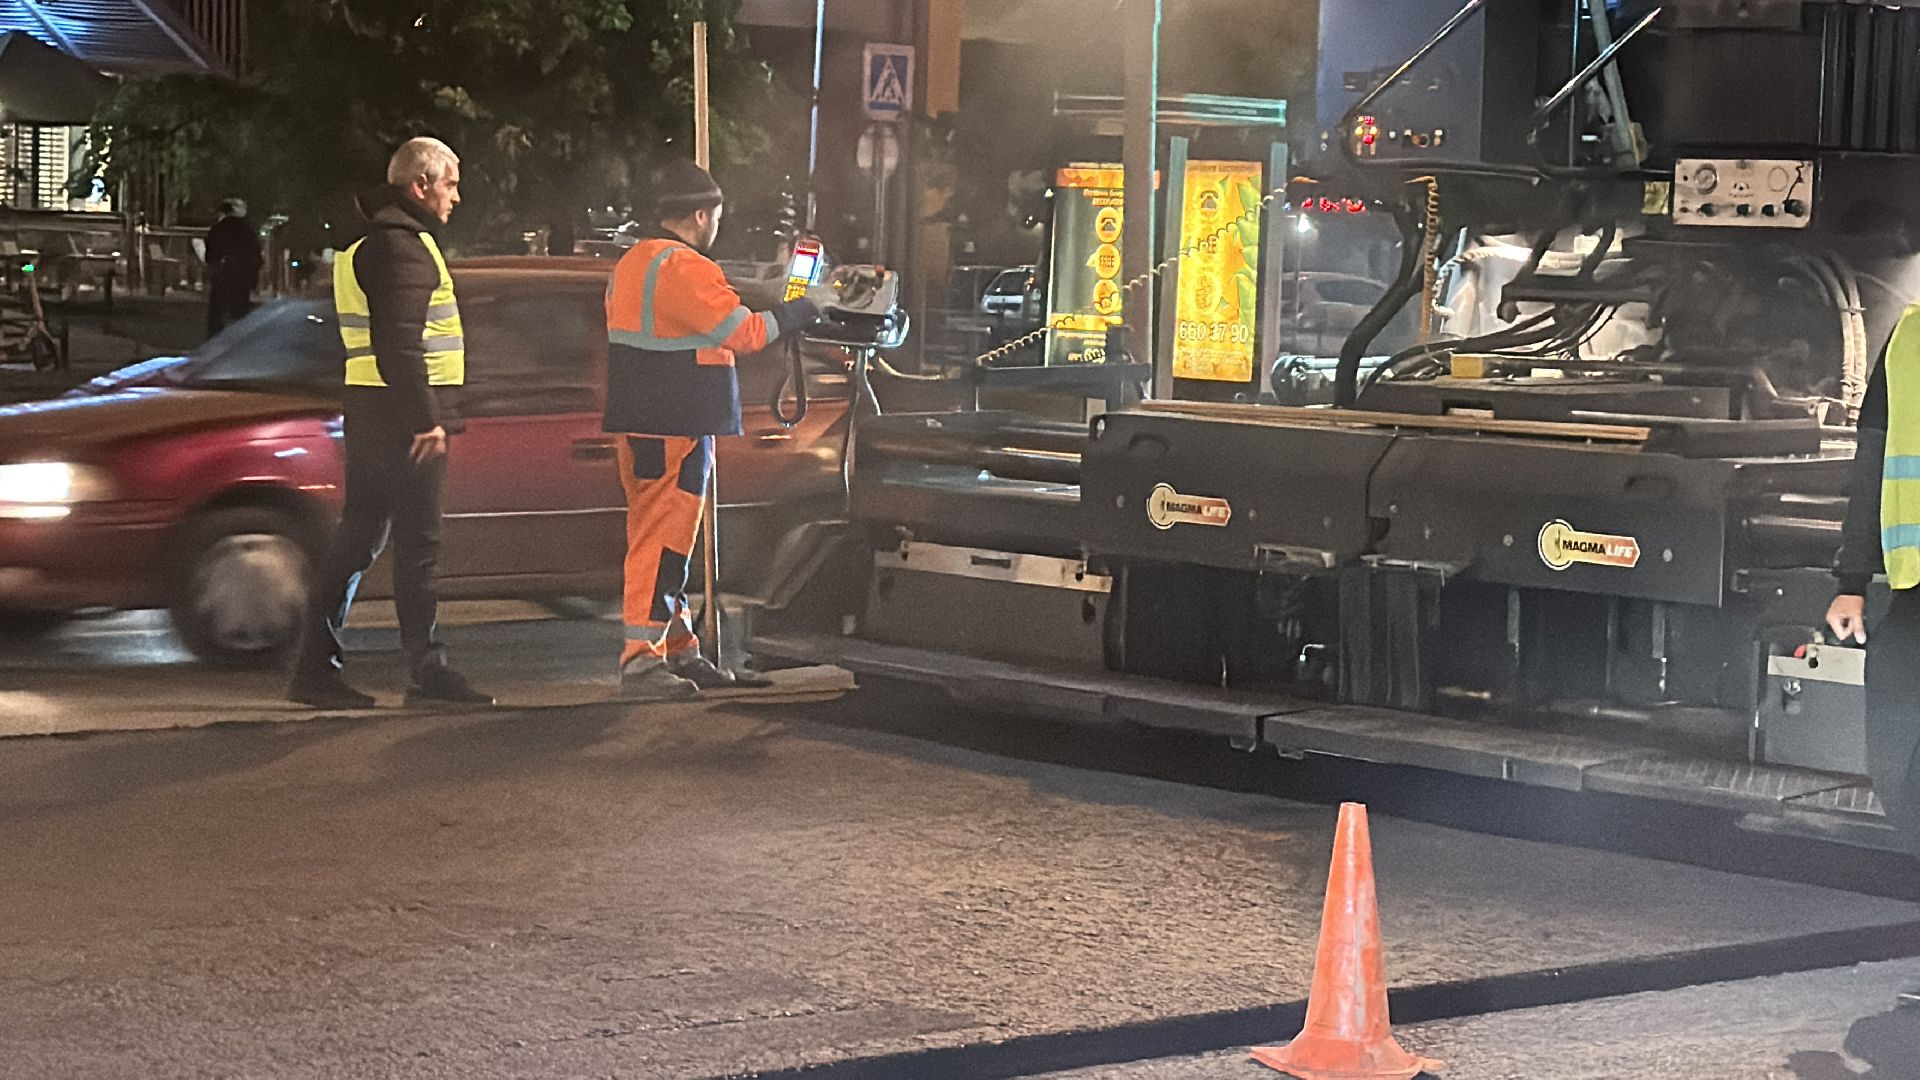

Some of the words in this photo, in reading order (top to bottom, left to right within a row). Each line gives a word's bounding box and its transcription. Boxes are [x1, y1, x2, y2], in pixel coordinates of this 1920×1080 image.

[1180, 320, 1206, 340] 660
[1209, 322, 1227, 343] 37
[1230, 323, 1249, 344] 90
